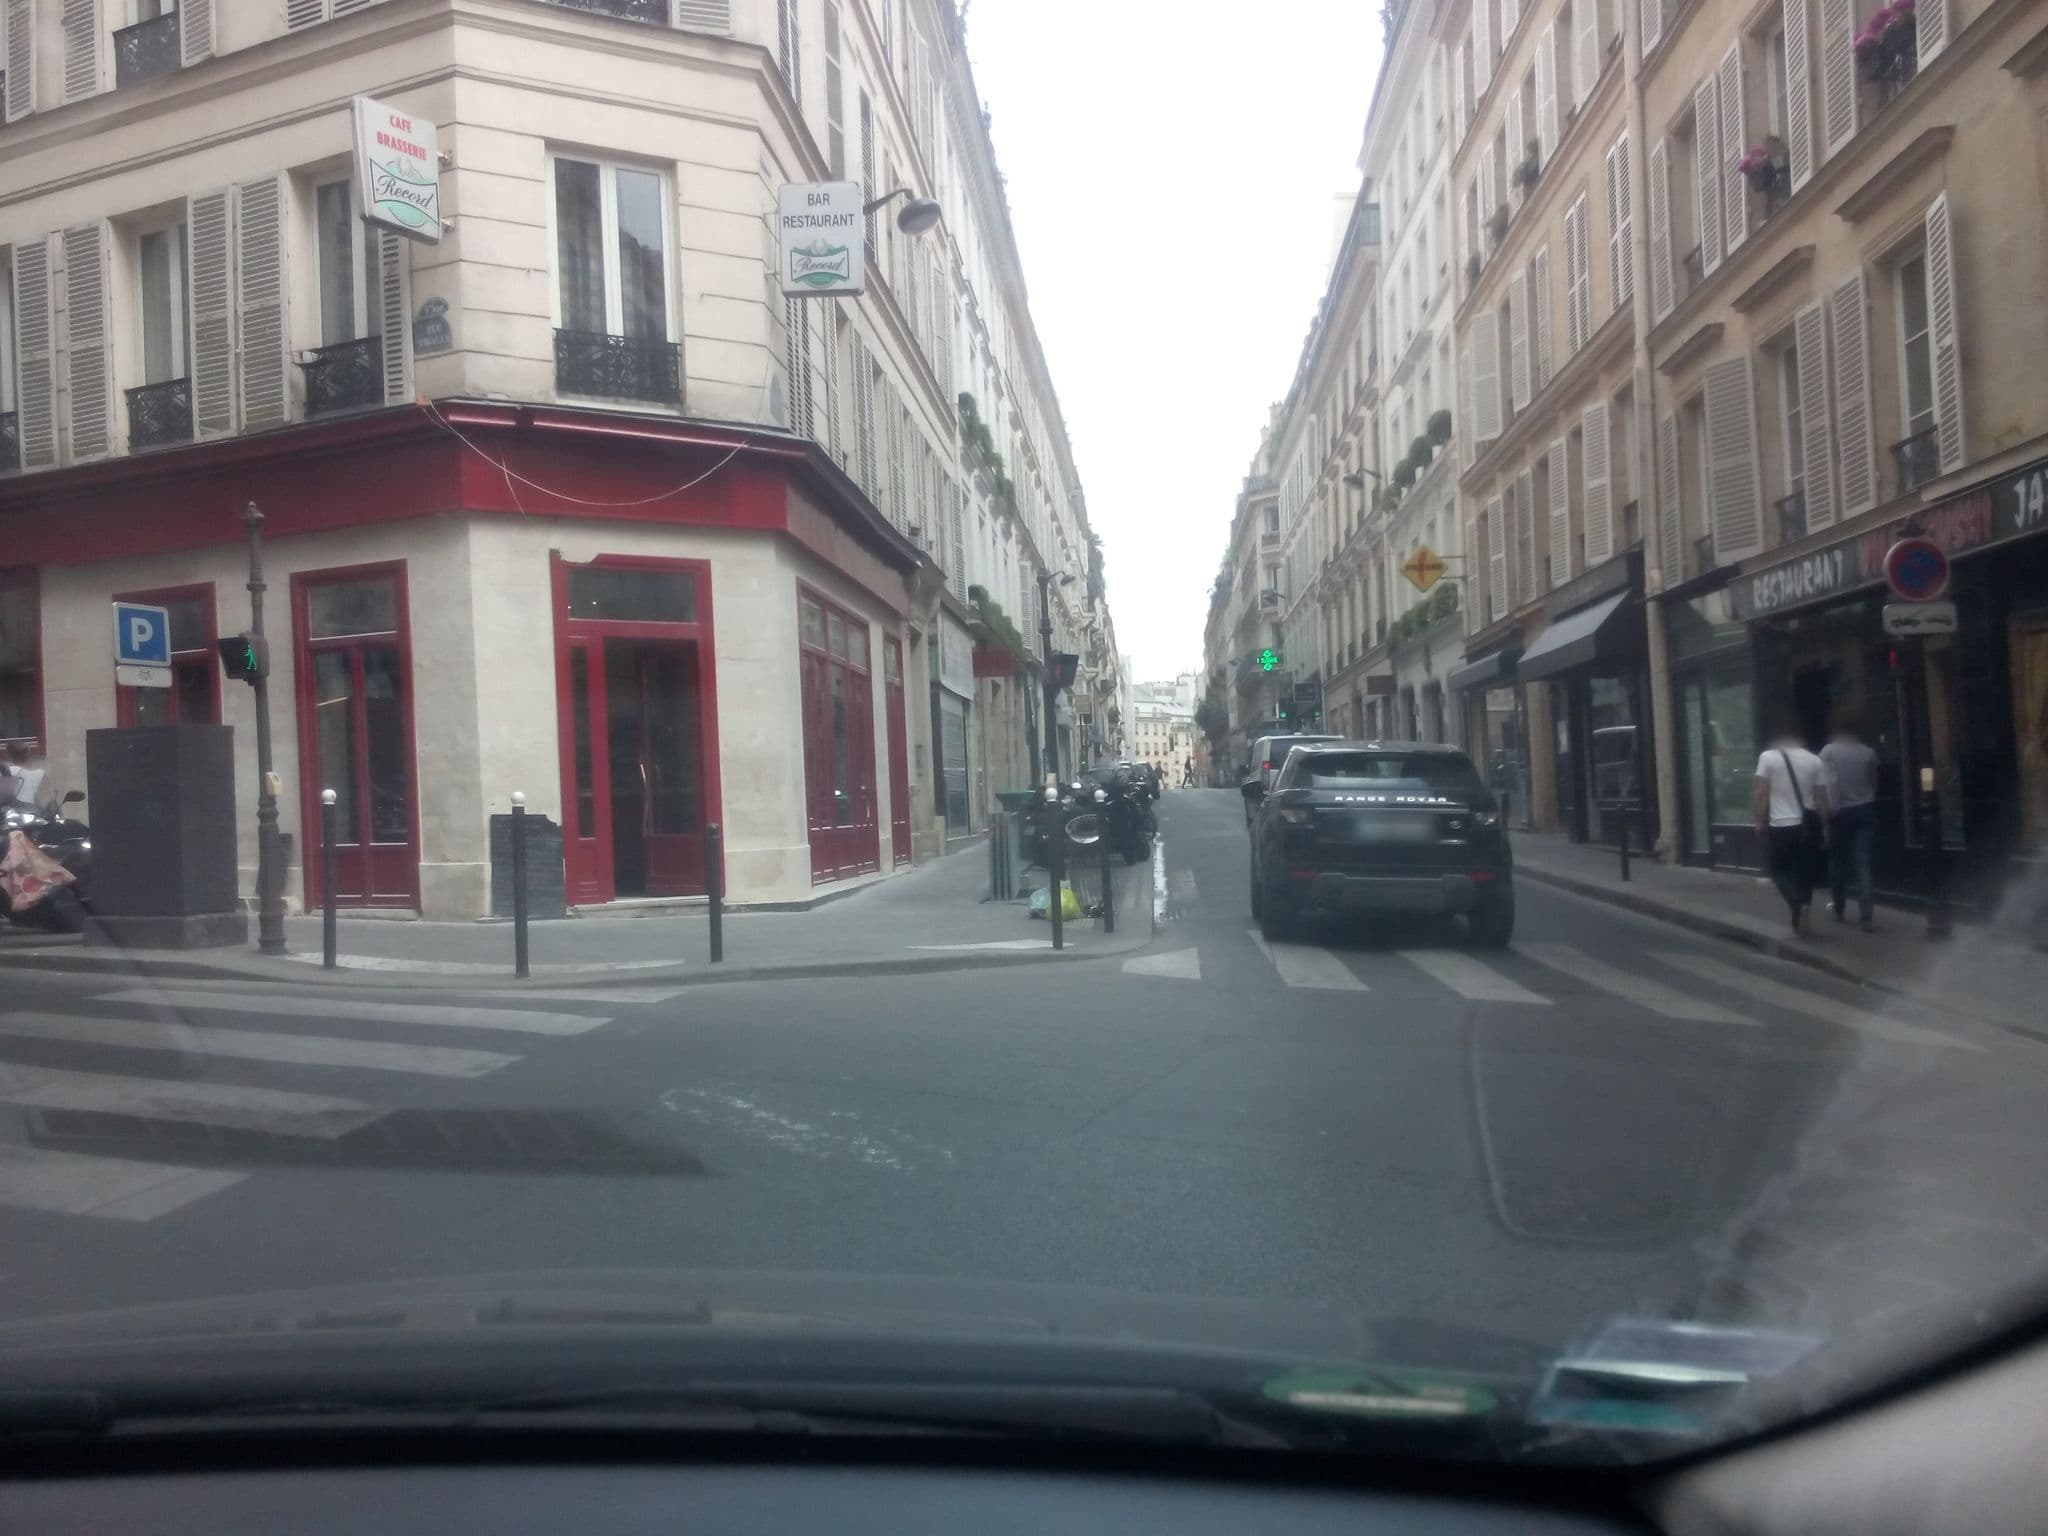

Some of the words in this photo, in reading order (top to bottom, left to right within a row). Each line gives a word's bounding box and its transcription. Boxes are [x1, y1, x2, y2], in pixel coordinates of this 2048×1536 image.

[376, 131, 427, 160] BRASSERIE
[375, 174, 434, 209] Record
[807, 193, 831, 206] BAR
[782, 213, 855, 229] RESTAURANT
[793, 256, 846, 274] Record
[1753, 549, 1844, 610] RESTAURANT
[130, 617, 154, 651] P
